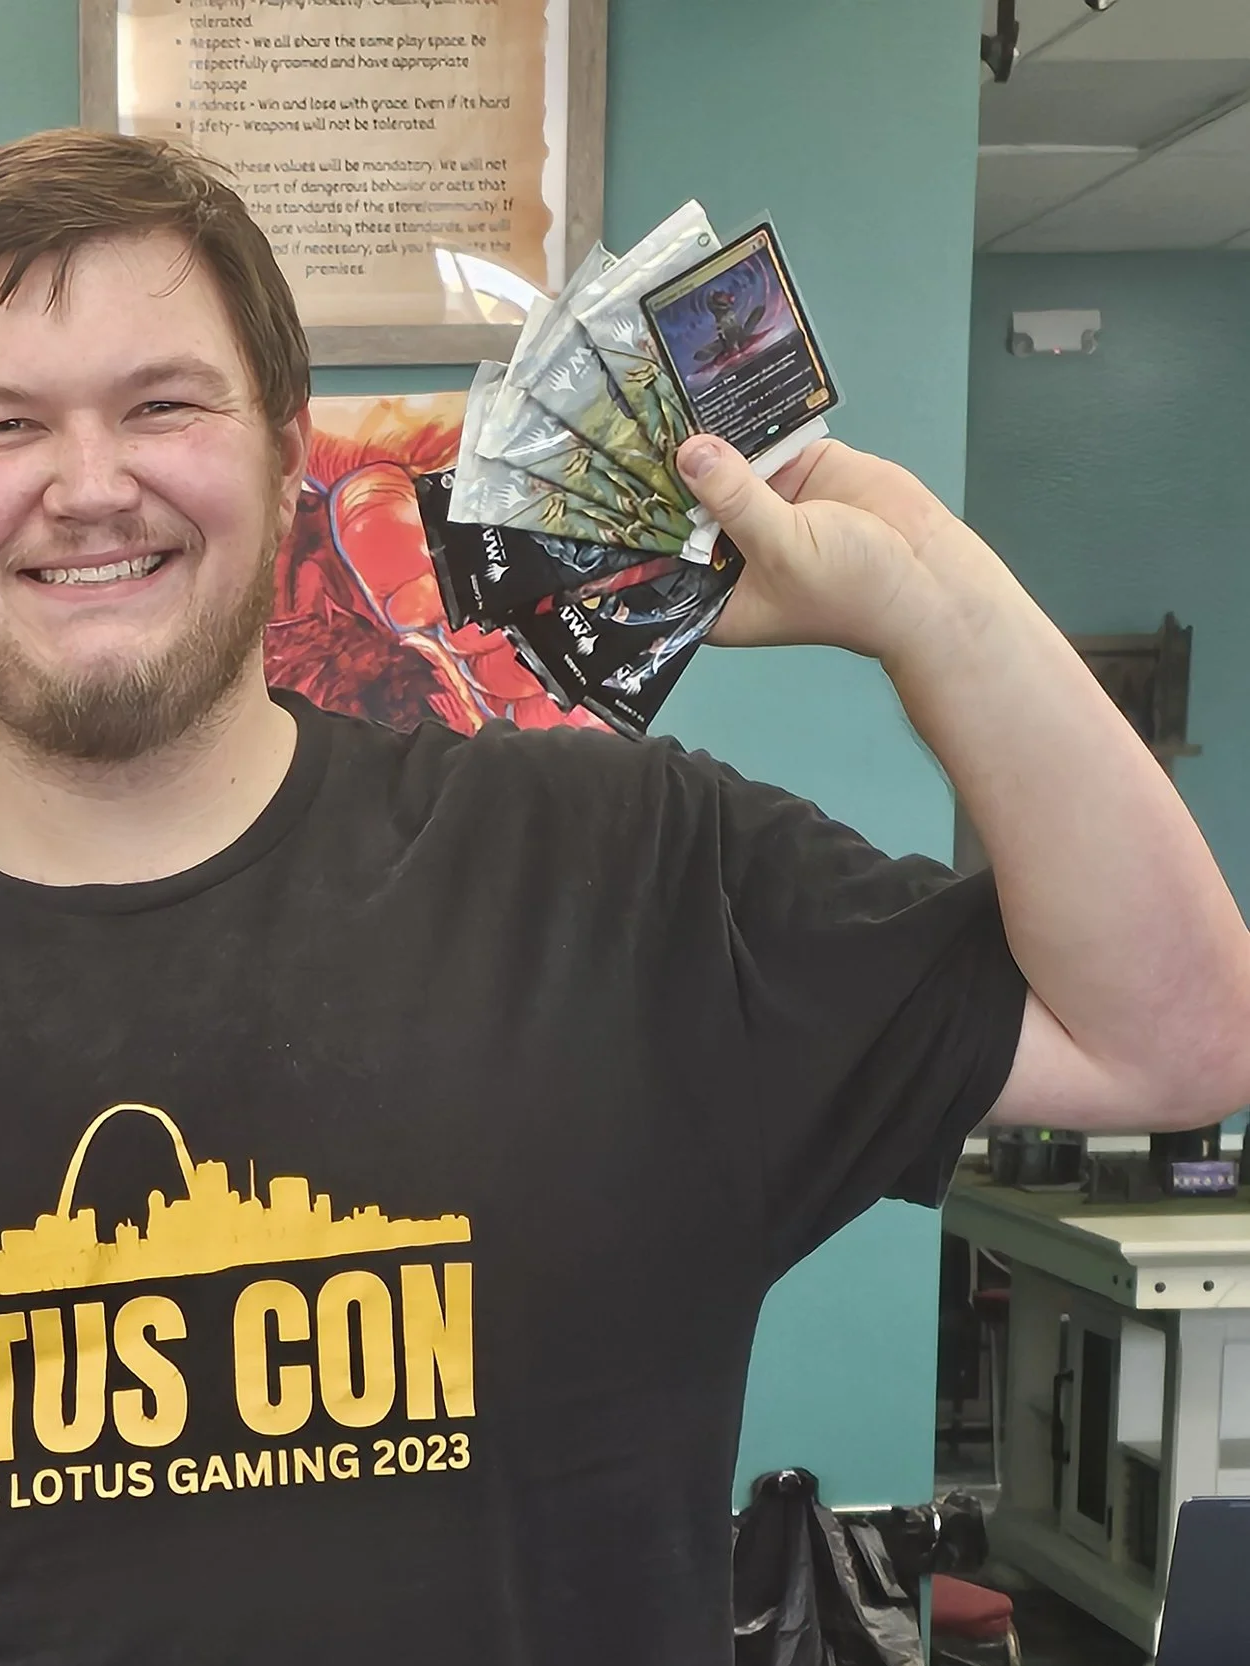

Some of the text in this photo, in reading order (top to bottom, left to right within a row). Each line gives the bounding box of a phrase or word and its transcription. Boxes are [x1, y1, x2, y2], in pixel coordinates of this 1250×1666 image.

[275, 34, 290, 48] all
[294, 34, 330, 48] share
[335, 34, 355, 47] the
[359, 36, 394, 47] same
[397, 34, 425, 50] play
[471, 33, 486, 47] Be
[190, 54, 469, 73] respectfully groomed and have appropriate
[258, 99, 280, 110] Win
[283, 97, 306, 110] and
[310, 97, 336, 110] lose
[340, 97, 368, 109] with
[414, 97, 444, 109] Even
[447, 94, 457, 109] if
[478, 93, 510, 109] hard
[243, 118, 299, 134] Weapons
[303, 116, 325, 131] will
[329, 118, 350, 131] not
[354, 116, 369, 131] be
[235, 160, 270, 172] these
[274, 160, 315, 172] values
[319, 159, 341, 171] will
[345, 159, 359, 171] be
[439, 159, 456, 171] We
[461, 158, 483, 171] will
[486, 159, 507, 171] not
[254, 181, 280, 194] sort
[284, 179, 298, 193] of
[301, 180, 367, 196] dangerous
[371, 178, 426, 192] behavior
[430, 182, 444, 192] or
[446, 180, 475, 192] acts
[479, 178, 506, 191] that
[251, 202, 271, 214] the
[276, 201, 342, 214] standards
[346, 199, 359, 213] of
[363, 200, 384, 213] the
[503, 197, 514, 211] If
[271, 224, 293, 234] are
[296, 221, 351, 236] violating
[355, 220, 390, 233] these
[468, 222, 485, 233] we
[489, 219, 510, 232] will
[305, 242, 372, 257] necessary,
[375, 240, 397, 254] ask
[401, 242, 423, 255] you
[233, 1262, 476, 1436] CON
[9, 1459, 155, 1508] LOTUS
[167, 1442, 360, 1494] GAMING
[372, 1432, 471, 1477] 2023
